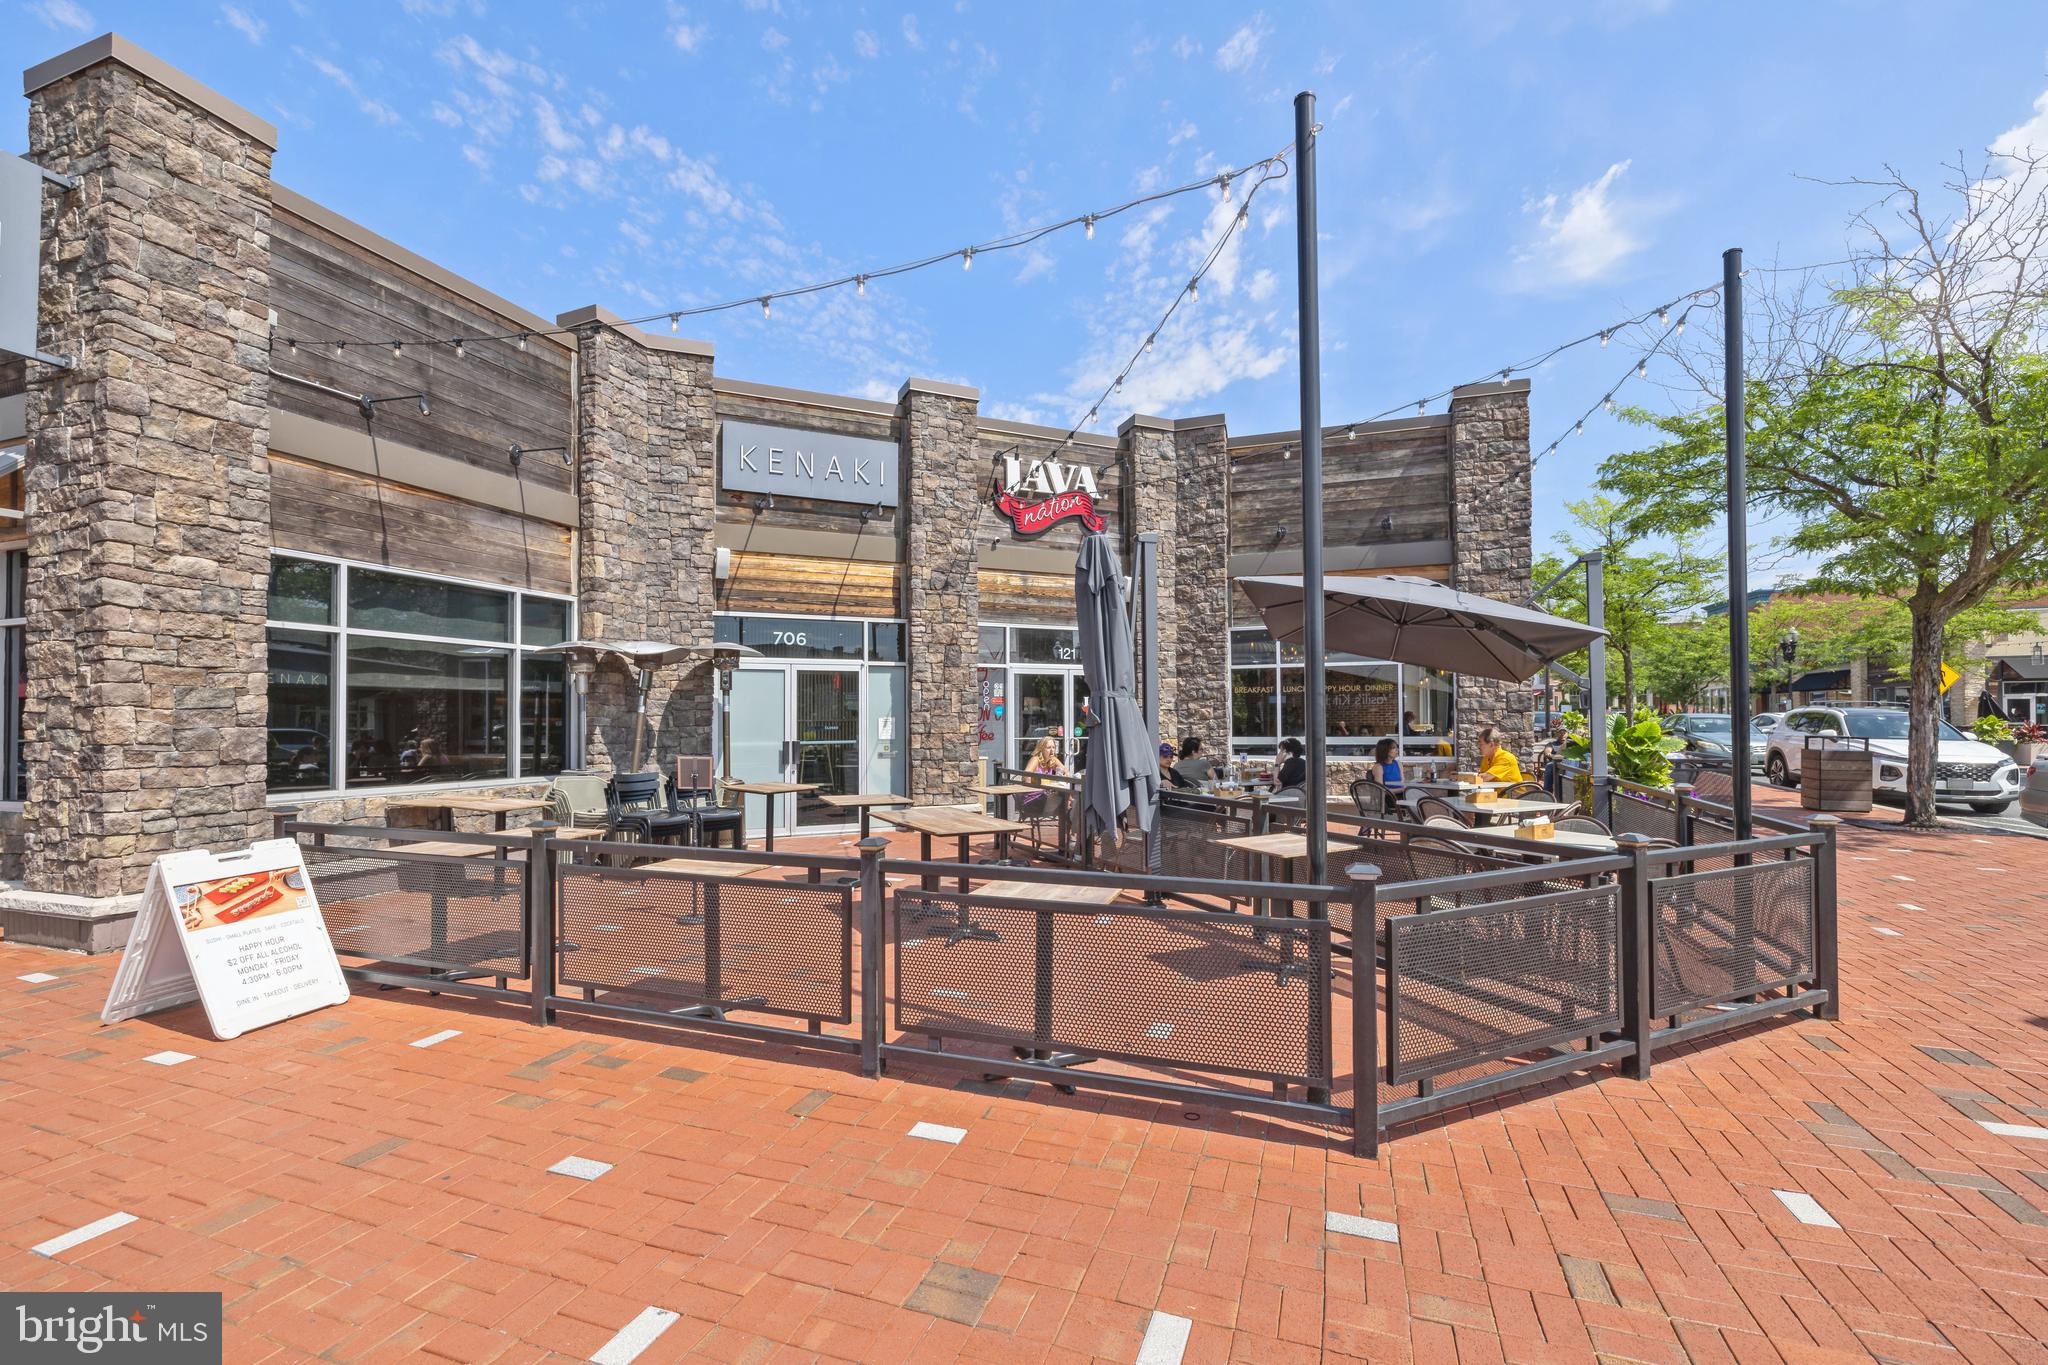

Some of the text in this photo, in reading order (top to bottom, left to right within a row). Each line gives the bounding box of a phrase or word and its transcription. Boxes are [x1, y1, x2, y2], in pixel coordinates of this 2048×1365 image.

[740, 444, 885, 487] KENAKI
[1003, 456, 1102, 499] JAVA
[1024, 495, 1083, 526] nation
[773, 631, 807, 646] 706
[1058, 648, 1076, 660] 121
[267, 672, 328, 686] ENAKI
[1234, 686, 1274, 694] BREAKFAST
[1282, 685, 1305, 693] LUNC
[1338, 684, 1361, 692] HOUR
[1364, 684, 1394, 692] DINNER
[239, 936, 285, 953] HAPPY HOUR
[227, 943, 302, 967] $2 OFF ALL ALCOHOL
[237, 954, 299, 975] MONDAY FRIDAY
[242, 972, 270, 985] 4:30PM
[236, 997, 251, 1007] DINE
[264, 985, 289, 998] TAKEOUT
[293, 978, 319, 991] DELIVERY
